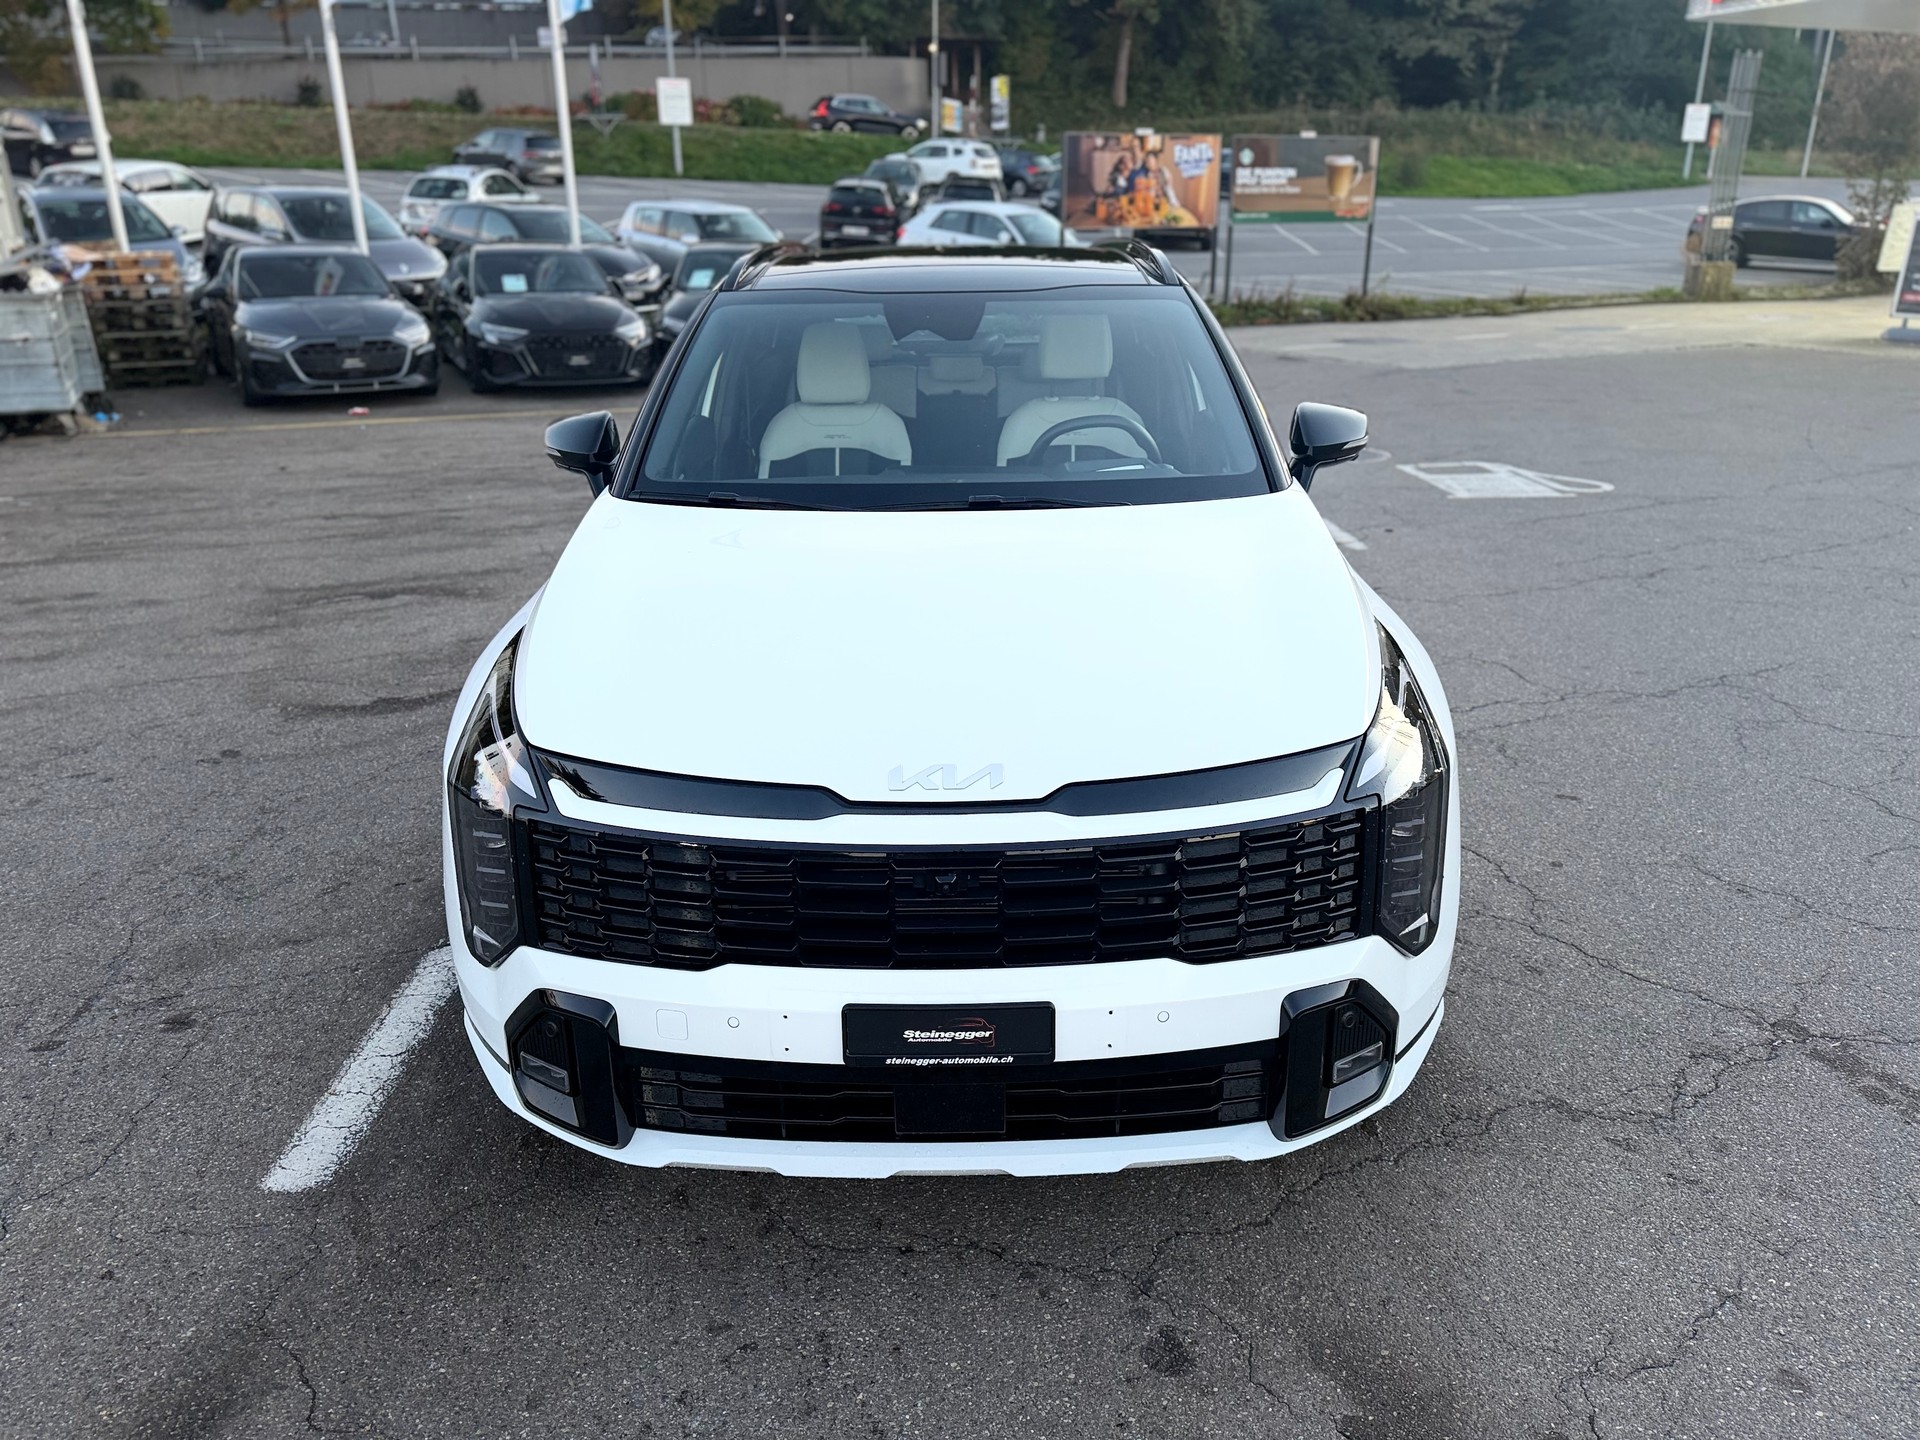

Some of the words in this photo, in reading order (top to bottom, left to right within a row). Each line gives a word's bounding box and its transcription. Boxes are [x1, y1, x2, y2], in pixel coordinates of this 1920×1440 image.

[888, 763, 1005, 791] KIA
[902, 1029, 994, 1040] Steinegger
[885, 1055, 1014, 1067] steinegger-automobile.ch
